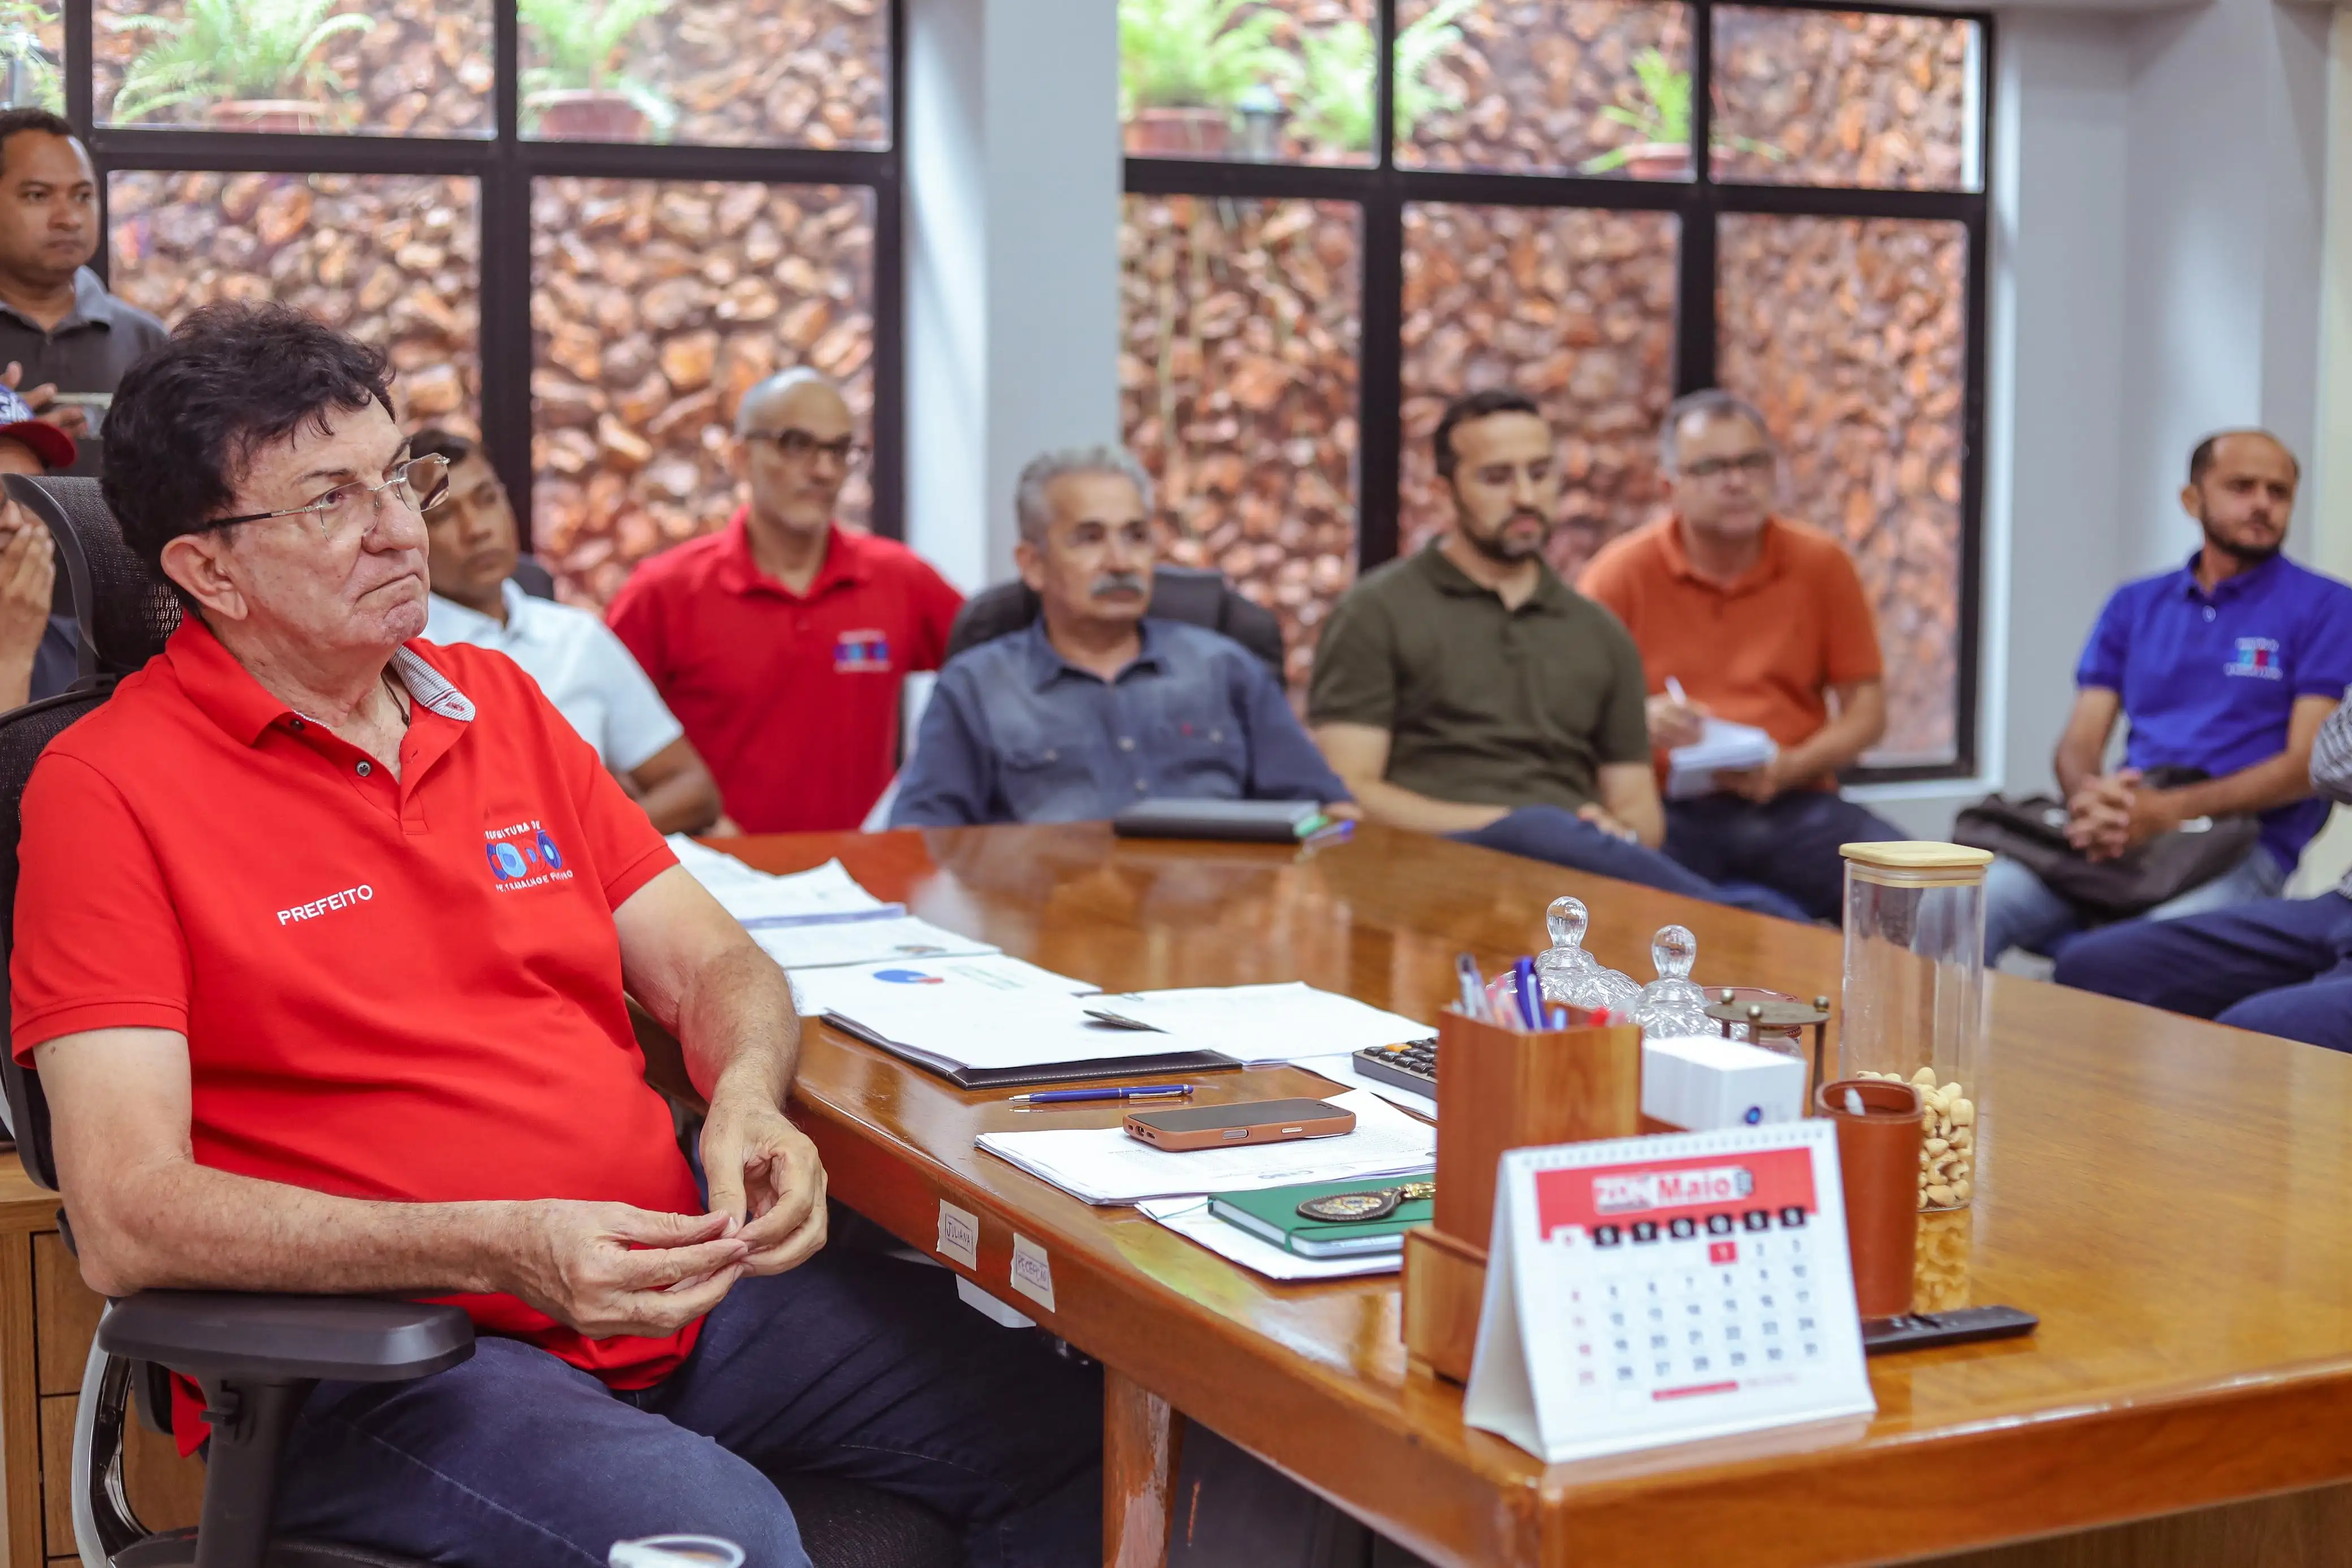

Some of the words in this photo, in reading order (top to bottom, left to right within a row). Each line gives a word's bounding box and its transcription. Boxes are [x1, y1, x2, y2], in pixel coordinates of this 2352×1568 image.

[485, 822, 530, 839] REFEITURA
[277, 884, 373, 926] PREFEITO
[1658, 1173, 1731, 1199] Maio
[946, 1221, 971, 1244] JULIANA
